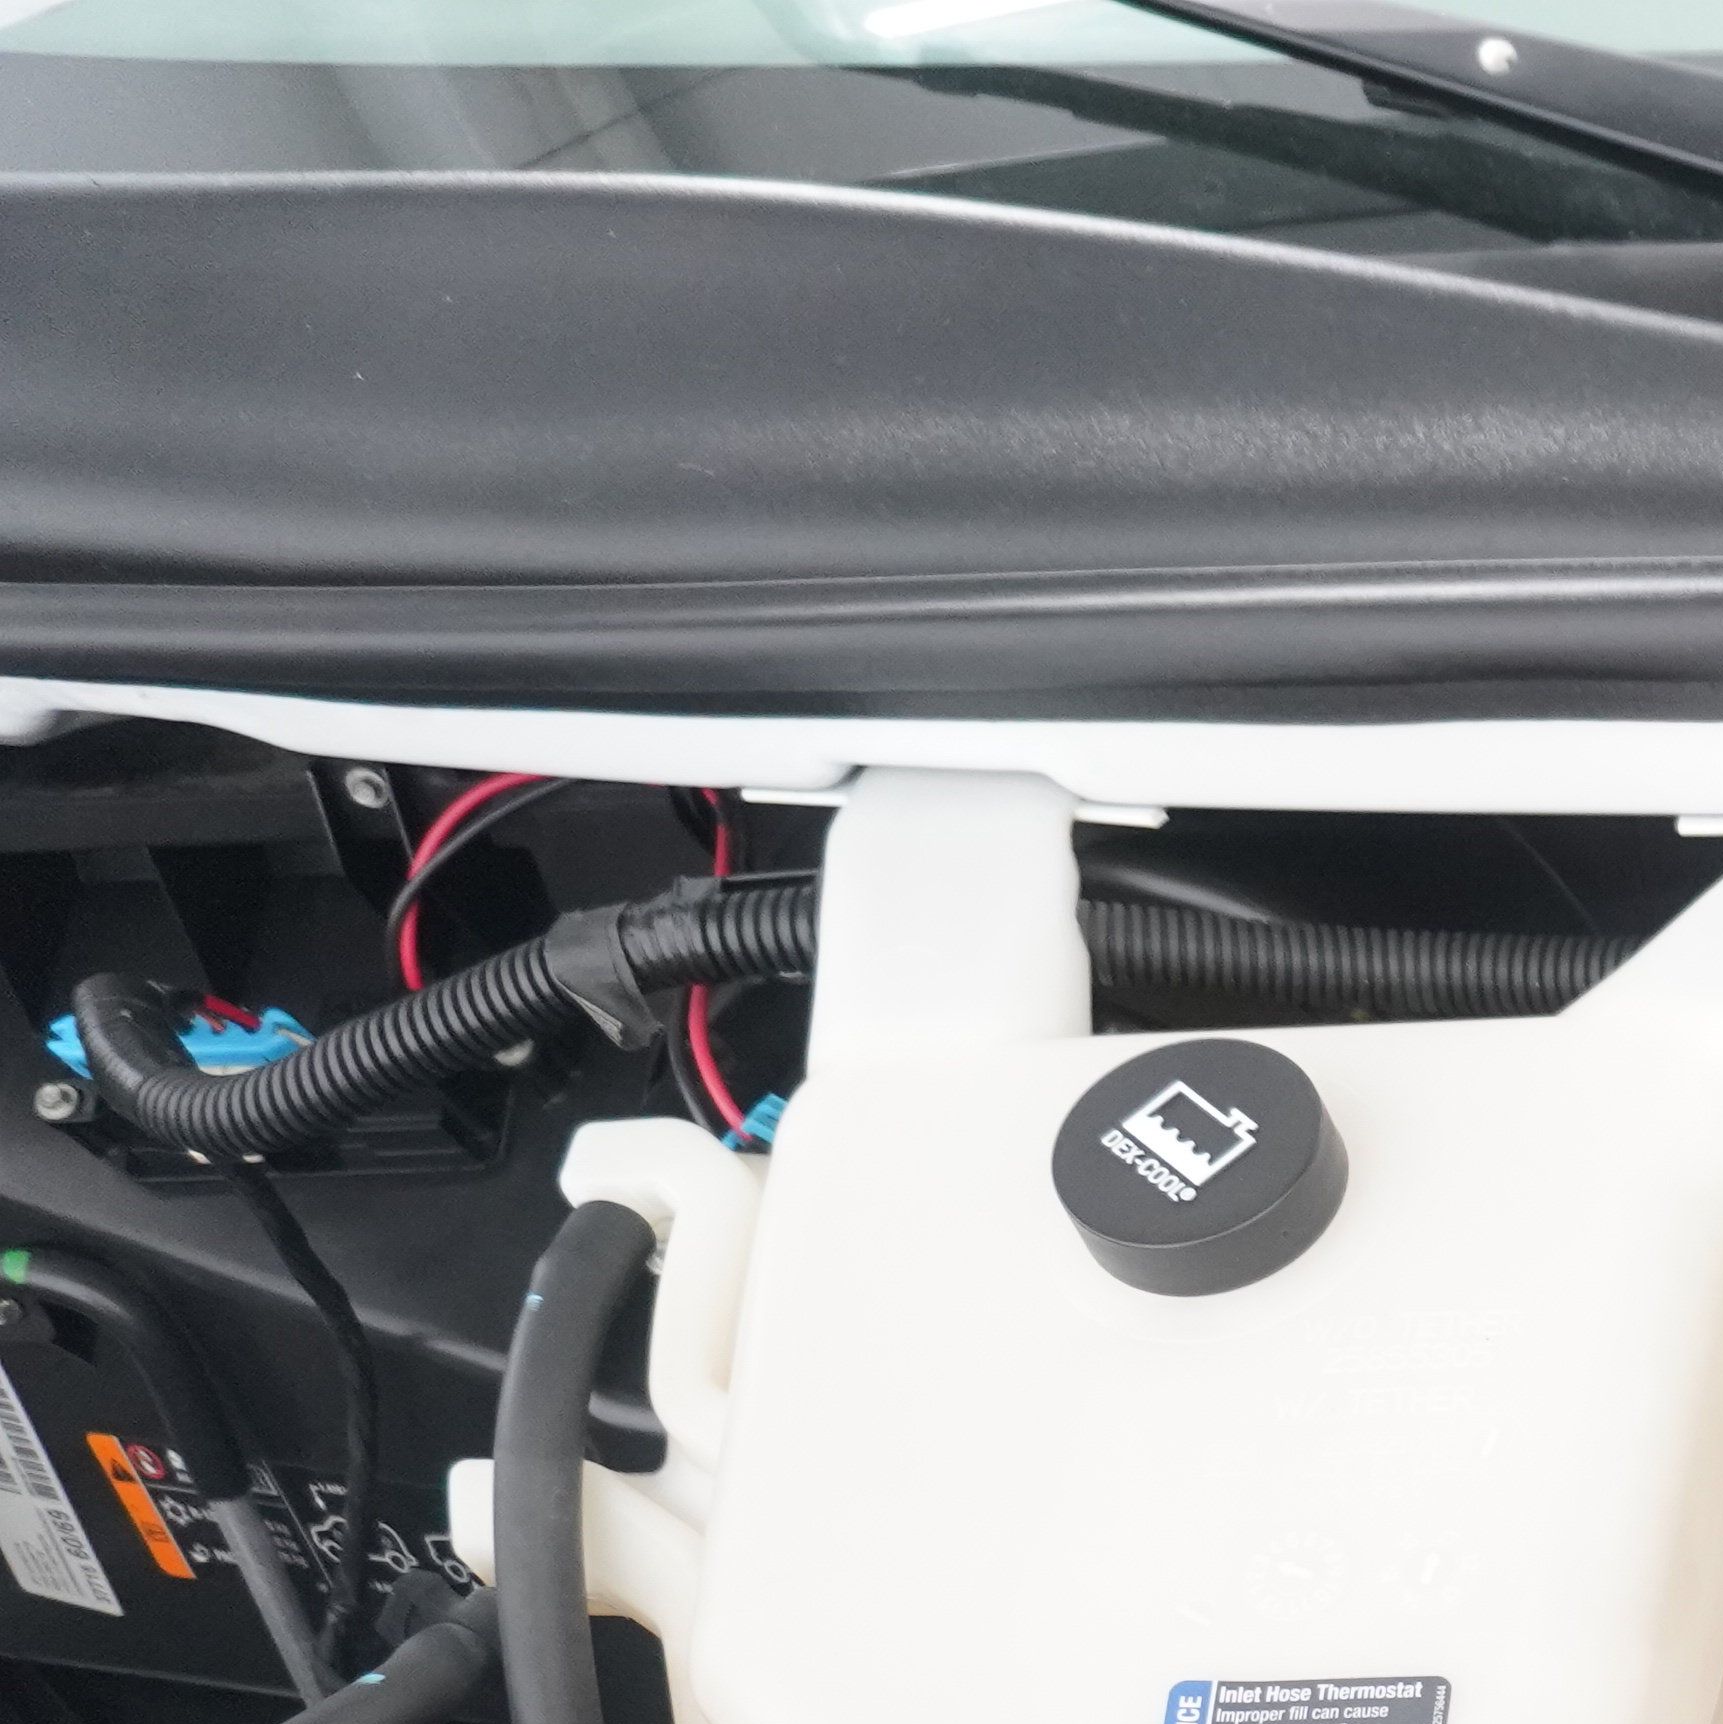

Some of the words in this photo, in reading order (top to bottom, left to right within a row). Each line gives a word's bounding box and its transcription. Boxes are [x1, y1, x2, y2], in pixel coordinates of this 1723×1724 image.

[1219, 1686, 1261, 1704] Inlet
[1266, 1685, 1311, 1703] Hose
[1317, 1682, 1423, 1701] Thermostat
[1216, 1707, 1284, 1724] Improper
[1289, 1705, 1307, 1720] fill
[1311, 1706, 1339, 1720] can
[1344, 1705, 1389, 1719] cause
